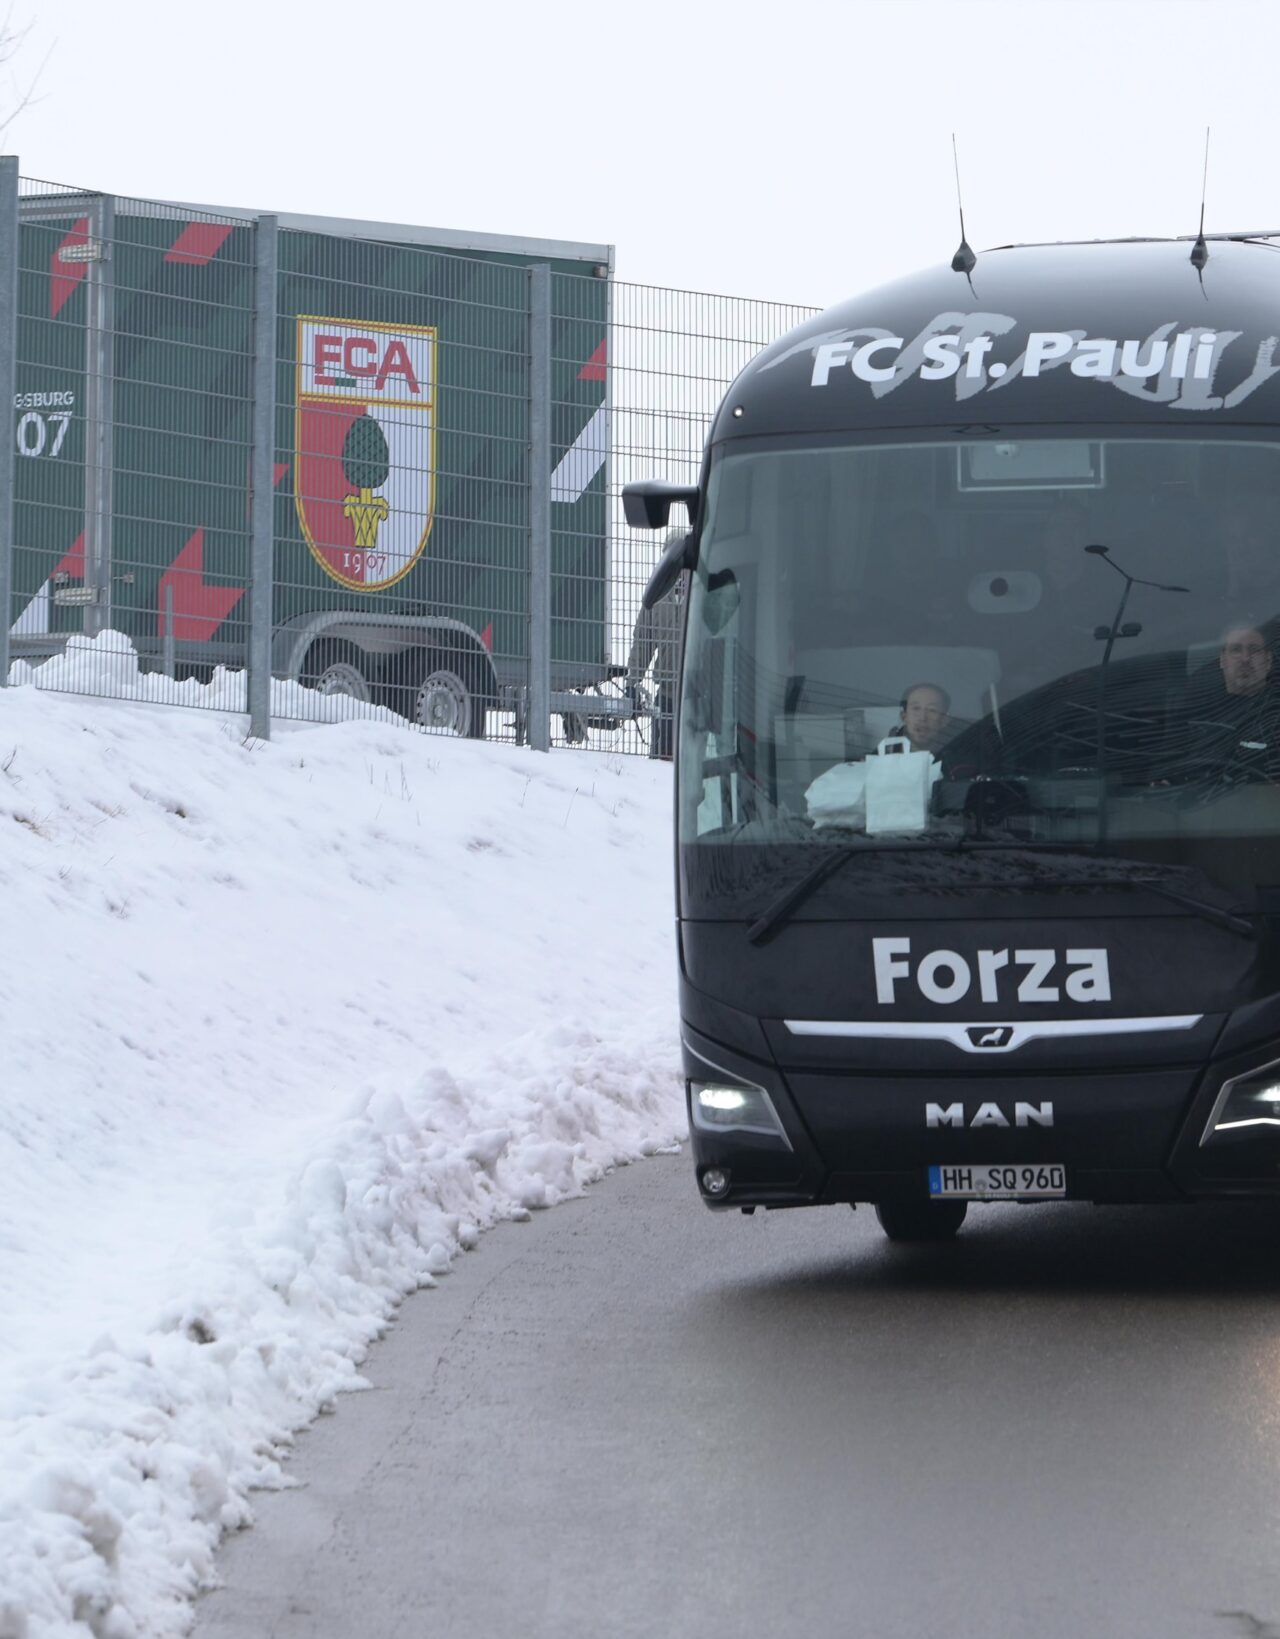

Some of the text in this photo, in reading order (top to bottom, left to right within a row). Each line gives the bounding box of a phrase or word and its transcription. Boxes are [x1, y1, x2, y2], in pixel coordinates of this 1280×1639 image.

[315, 334, 420, 394] FCA
[811, 333, 1217, 387] FC St. Pauli
[344, 552, 387, 575] 1907
[872, 937, 1112, 1004] Forza
[926, 1101, 1054, 1128] MAN
[943, 1168, 973, 1190] HH
[988, 1168, 1017, 1190] SQ
[1021, 1167, 1064, 1190] 960
